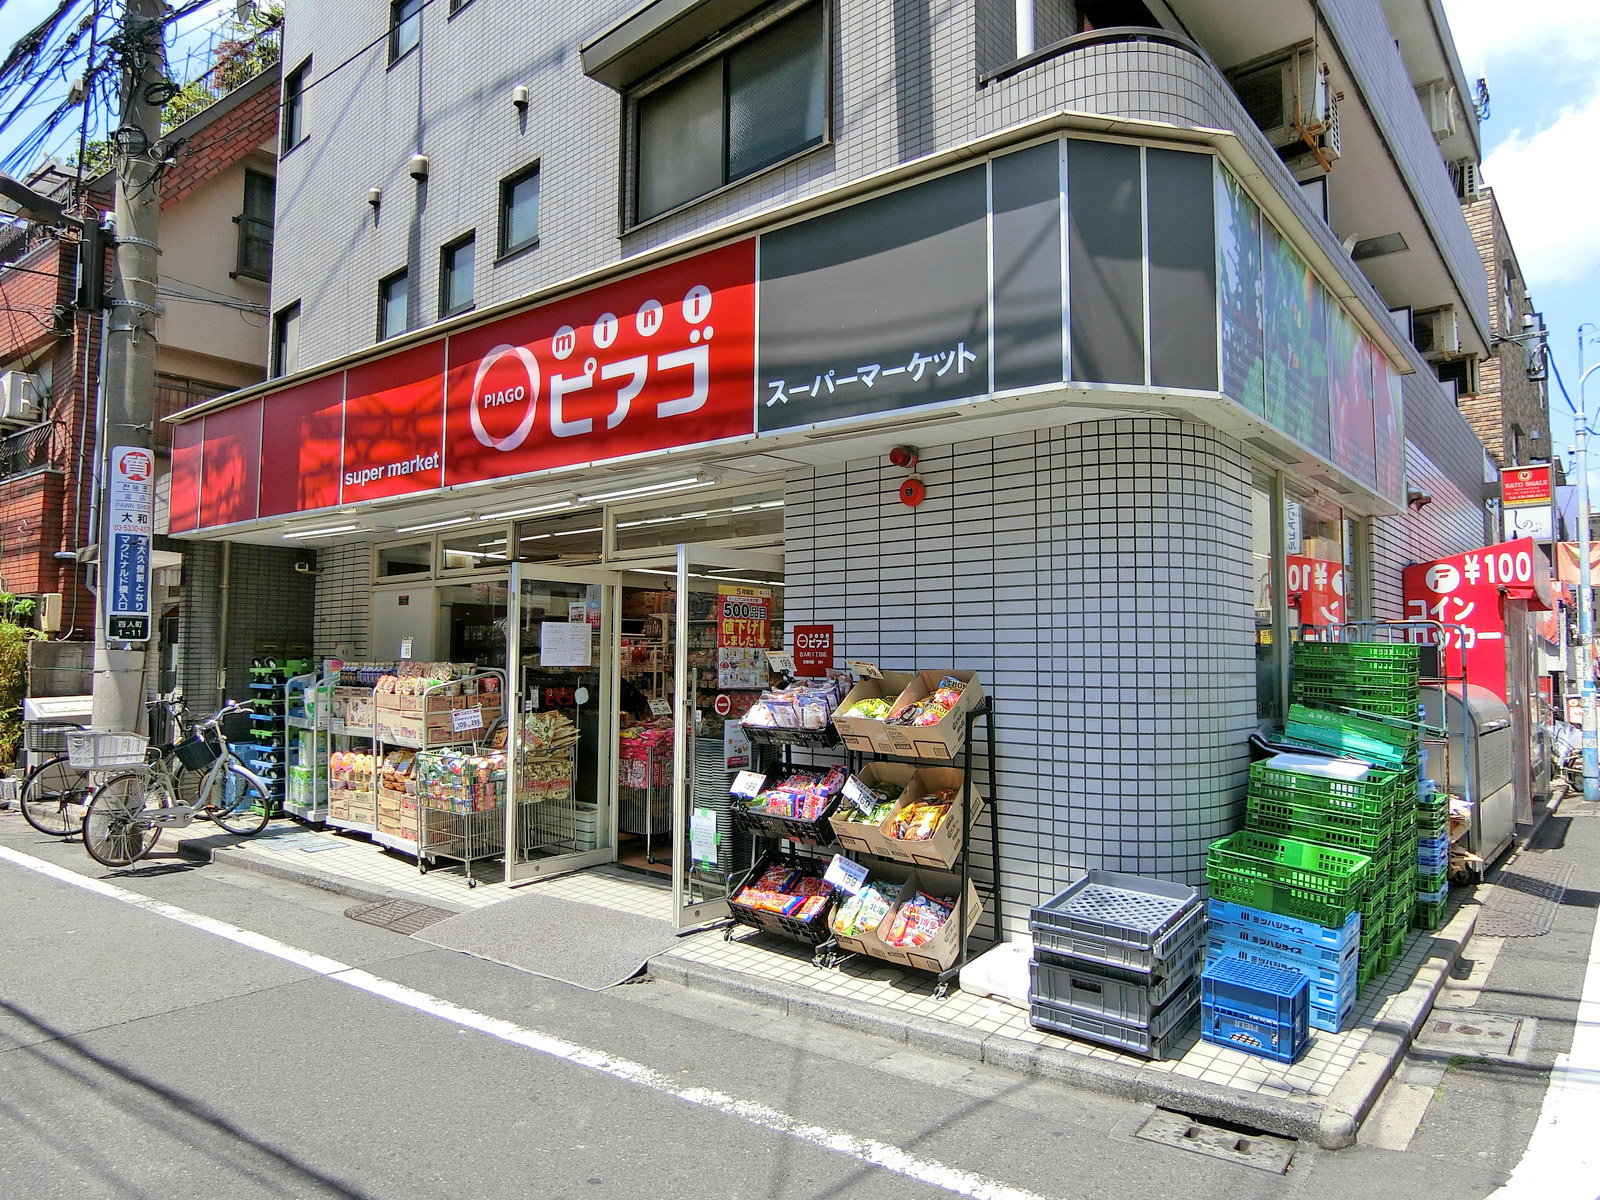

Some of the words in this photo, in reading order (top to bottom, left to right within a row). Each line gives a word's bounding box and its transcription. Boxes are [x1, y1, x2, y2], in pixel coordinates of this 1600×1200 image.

[553, 289, 706, 355] mini
[550, 325, 714, 438] ピアゴ
[766, 342, 977, 408] スーパーマーケット
[483, 385, 525, 409] PIAGO
[344, 464, 385, 488] super
[386, 450, 440, 479] market
[121, 512, 148, 525] 大和
[114, 524, 151, 533] 03-5330-457
[1464, 551, 1531, 586] ¥100
[723, 602, 767, 620] 500品目
[1408, 596, 1475, 622] コイン
[118, 620, 143, 629] 百人町
[118, 629, 142, 637] 1-11
[722, 618, 760, 636] 値下げ
[808, 638, 830, 649] ピアゴ
[857, 793, 871, 808] 169
[842, 872, 858, 887] 159
[1252, 915, 1304, 936] ミツハシライス
[1251, 936, 1303, 955] ミツハシライス
